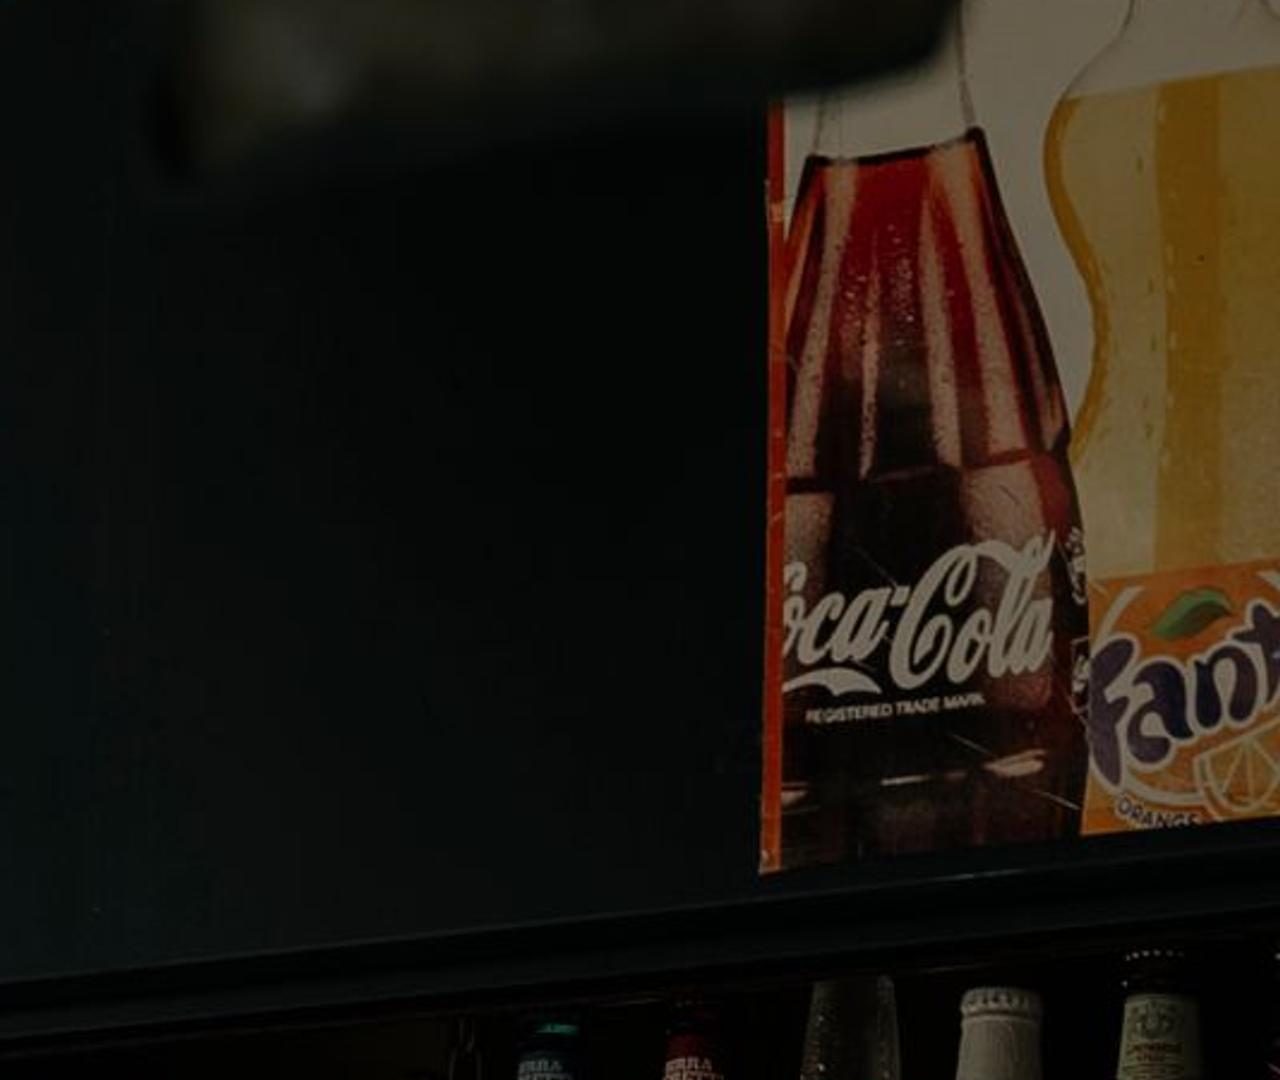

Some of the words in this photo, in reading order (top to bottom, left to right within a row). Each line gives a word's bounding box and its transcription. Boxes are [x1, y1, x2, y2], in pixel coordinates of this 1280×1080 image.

[783, 529, 1056, 690] oca-Cola
[805, 703, 894, 725] REGISTERED
[895, 697, 940, 716] TRADE
[943, 691, 987, 710] MARK
